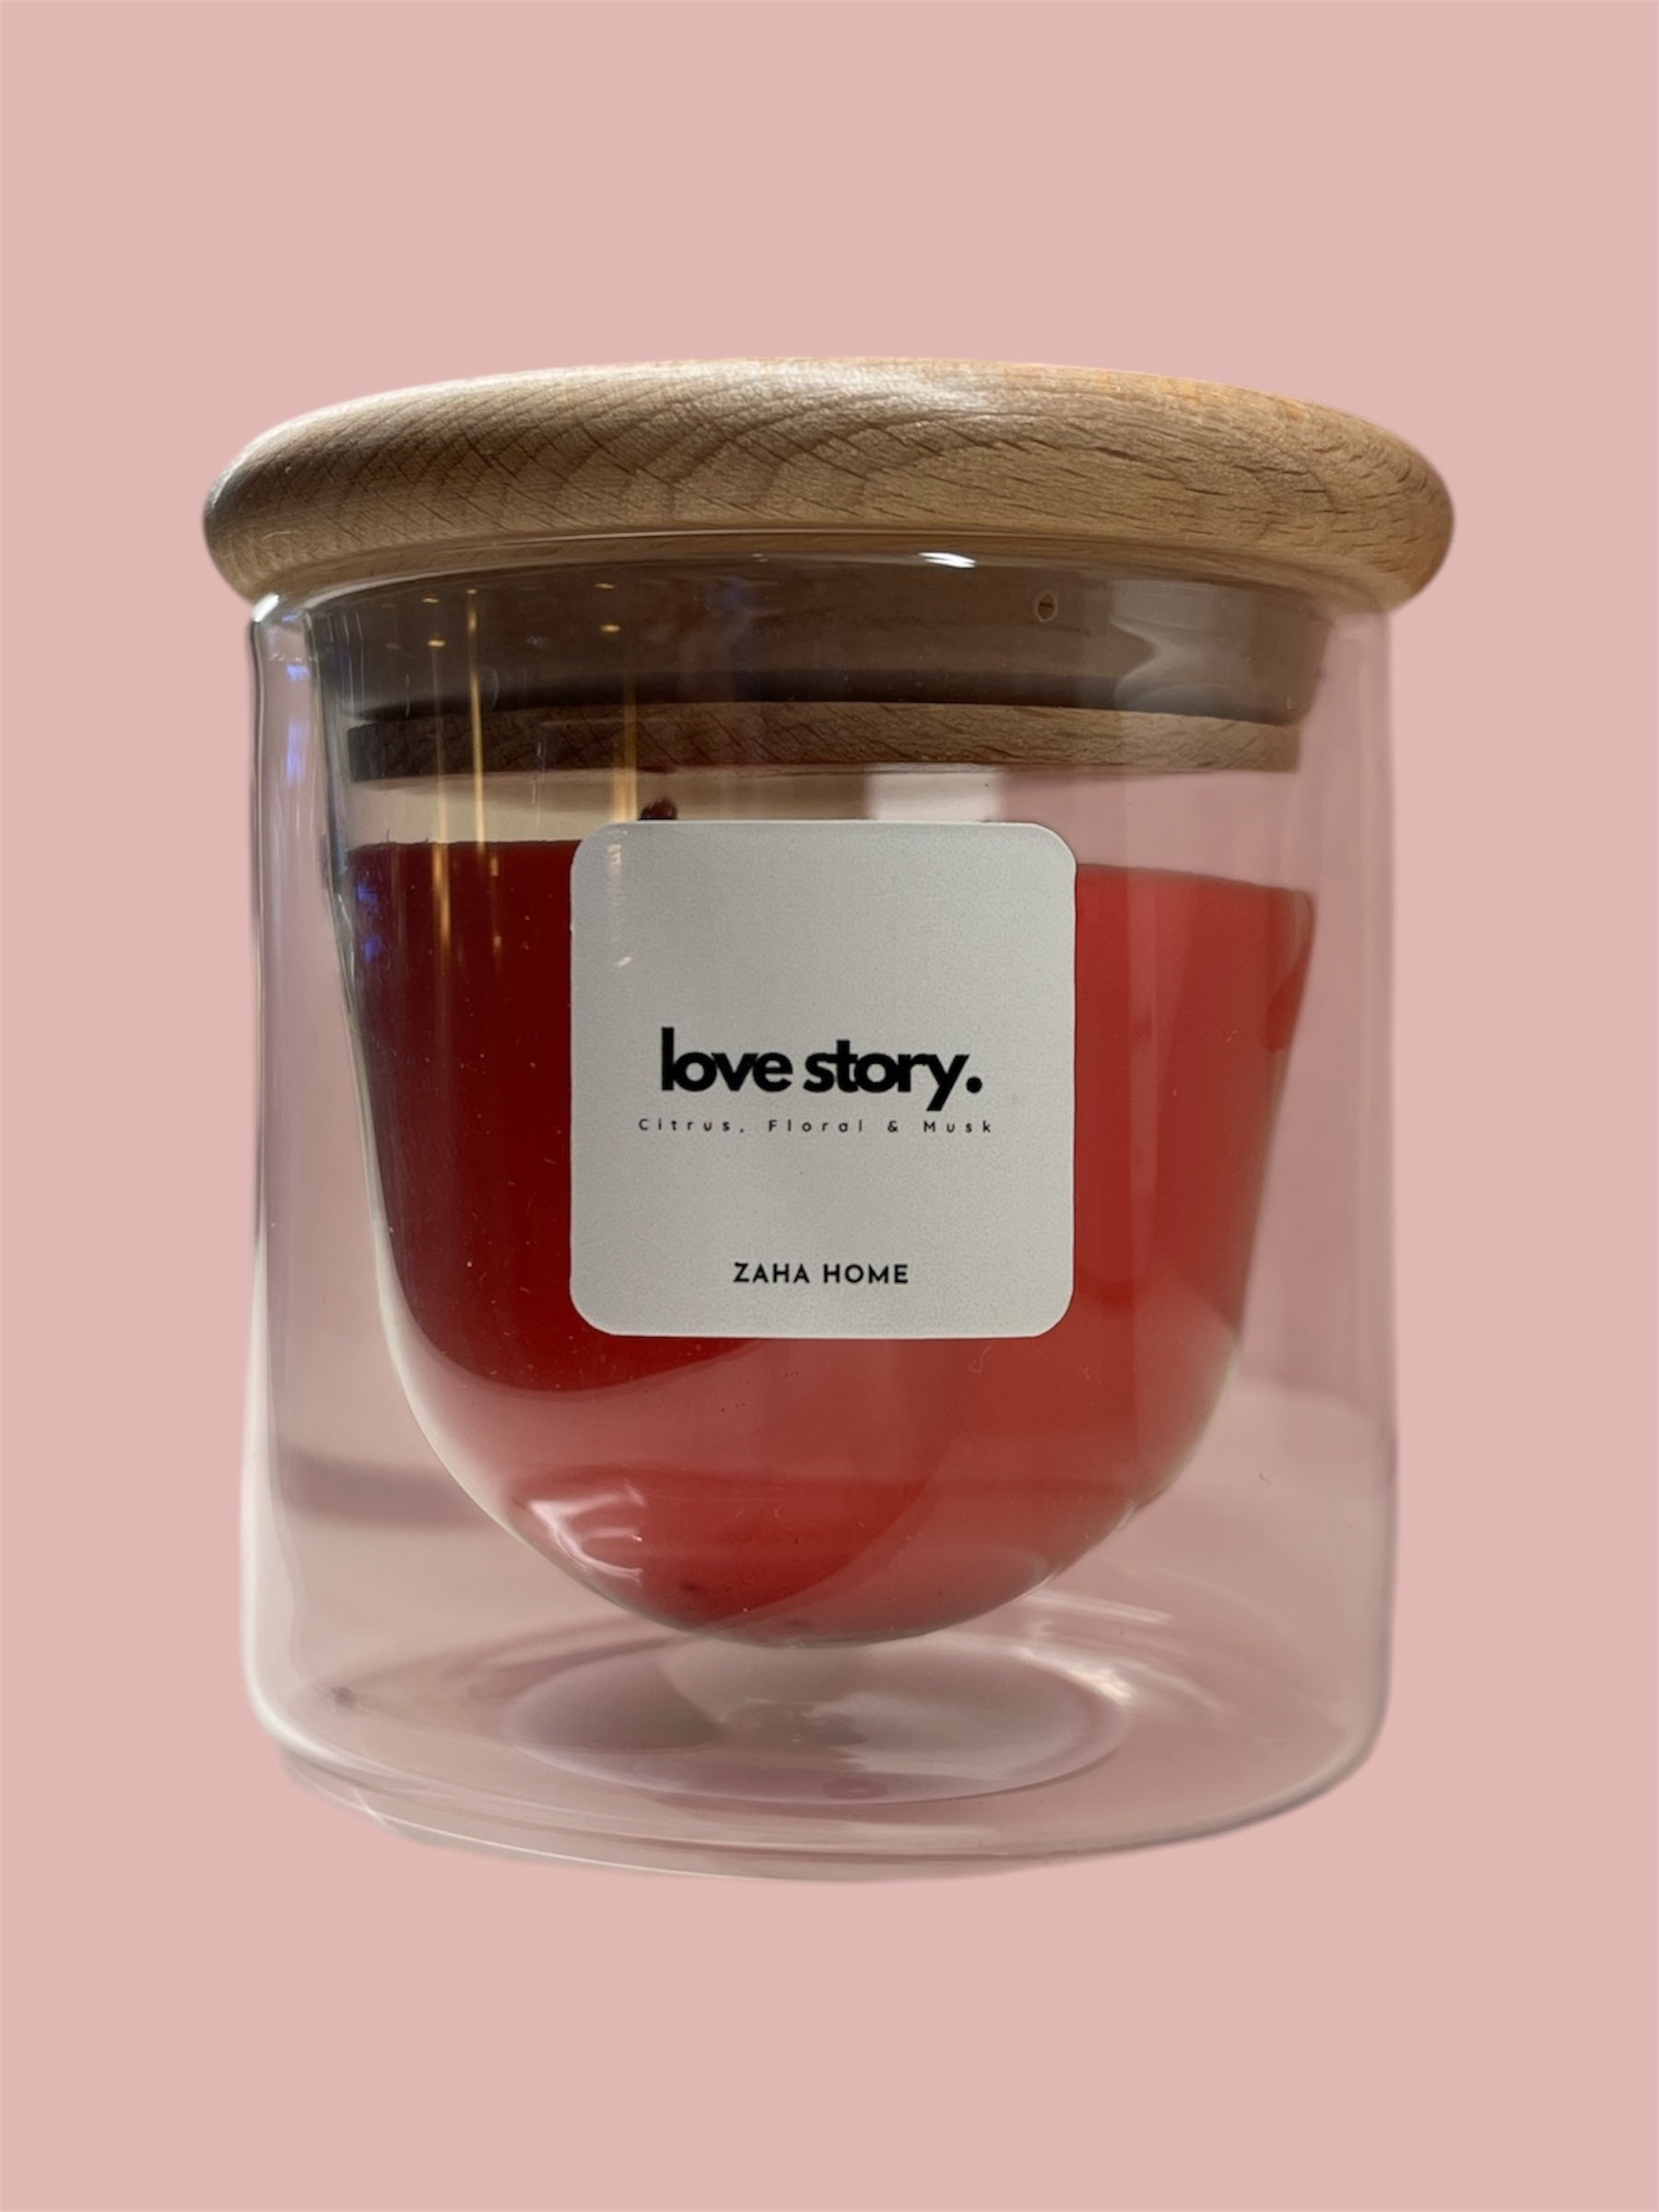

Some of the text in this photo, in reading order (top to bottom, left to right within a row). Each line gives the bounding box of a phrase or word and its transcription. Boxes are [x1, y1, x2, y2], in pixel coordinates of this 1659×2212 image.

[661, 1026, 983, 1112] love story.
[638, 1118, 994, 1135] Citrus, Floral & Musk
[733, 1262, 909, 1285] ZAHA HOME
